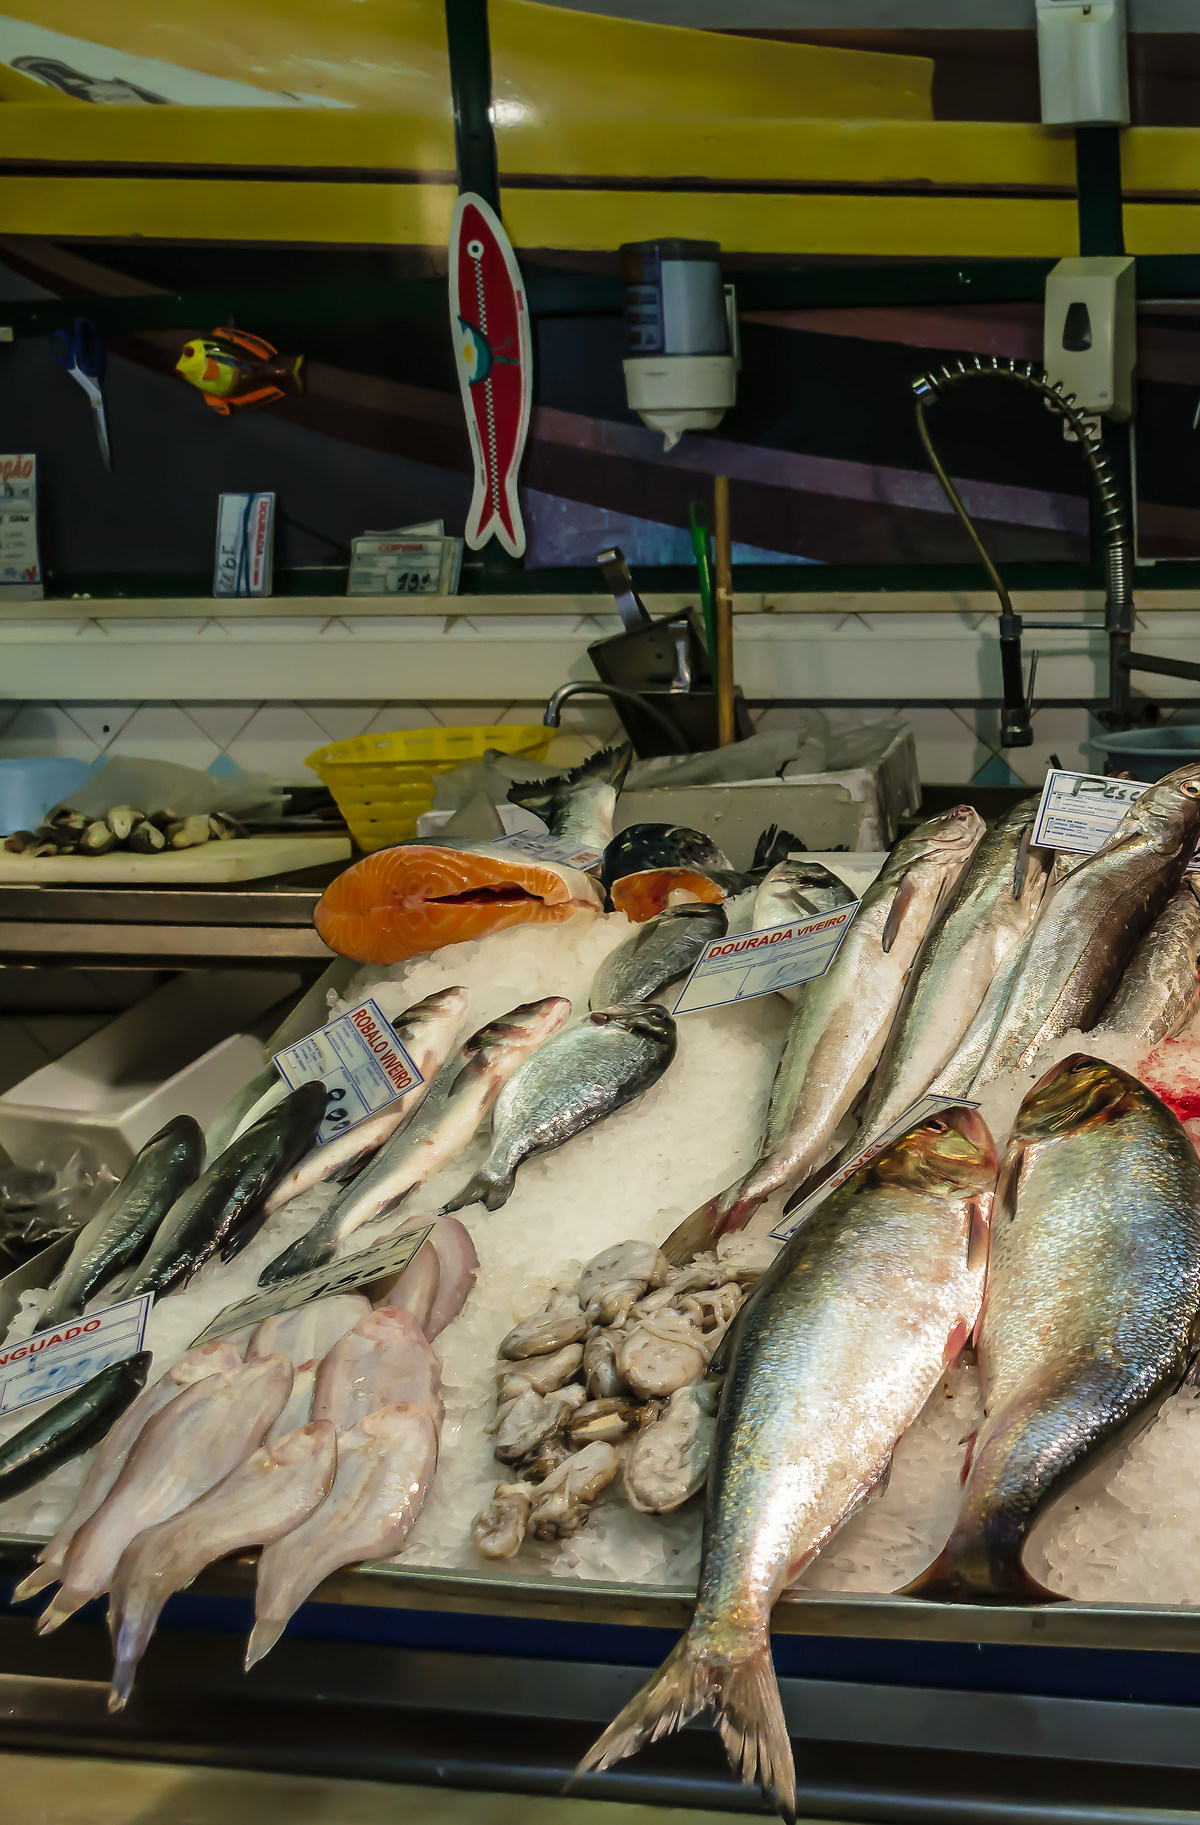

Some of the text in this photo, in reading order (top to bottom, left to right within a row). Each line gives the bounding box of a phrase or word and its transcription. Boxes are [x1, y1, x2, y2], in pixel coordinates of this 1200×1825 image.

[256, 500, 269, 557] DOURADA
[708, 929, 793, 959] DOURADA
[797, 914, 847, 937] VIVEIRO
[351, 1008, 389, 1054] ROBALO
[379, 1048, 413, 1090] VIVEIRO
